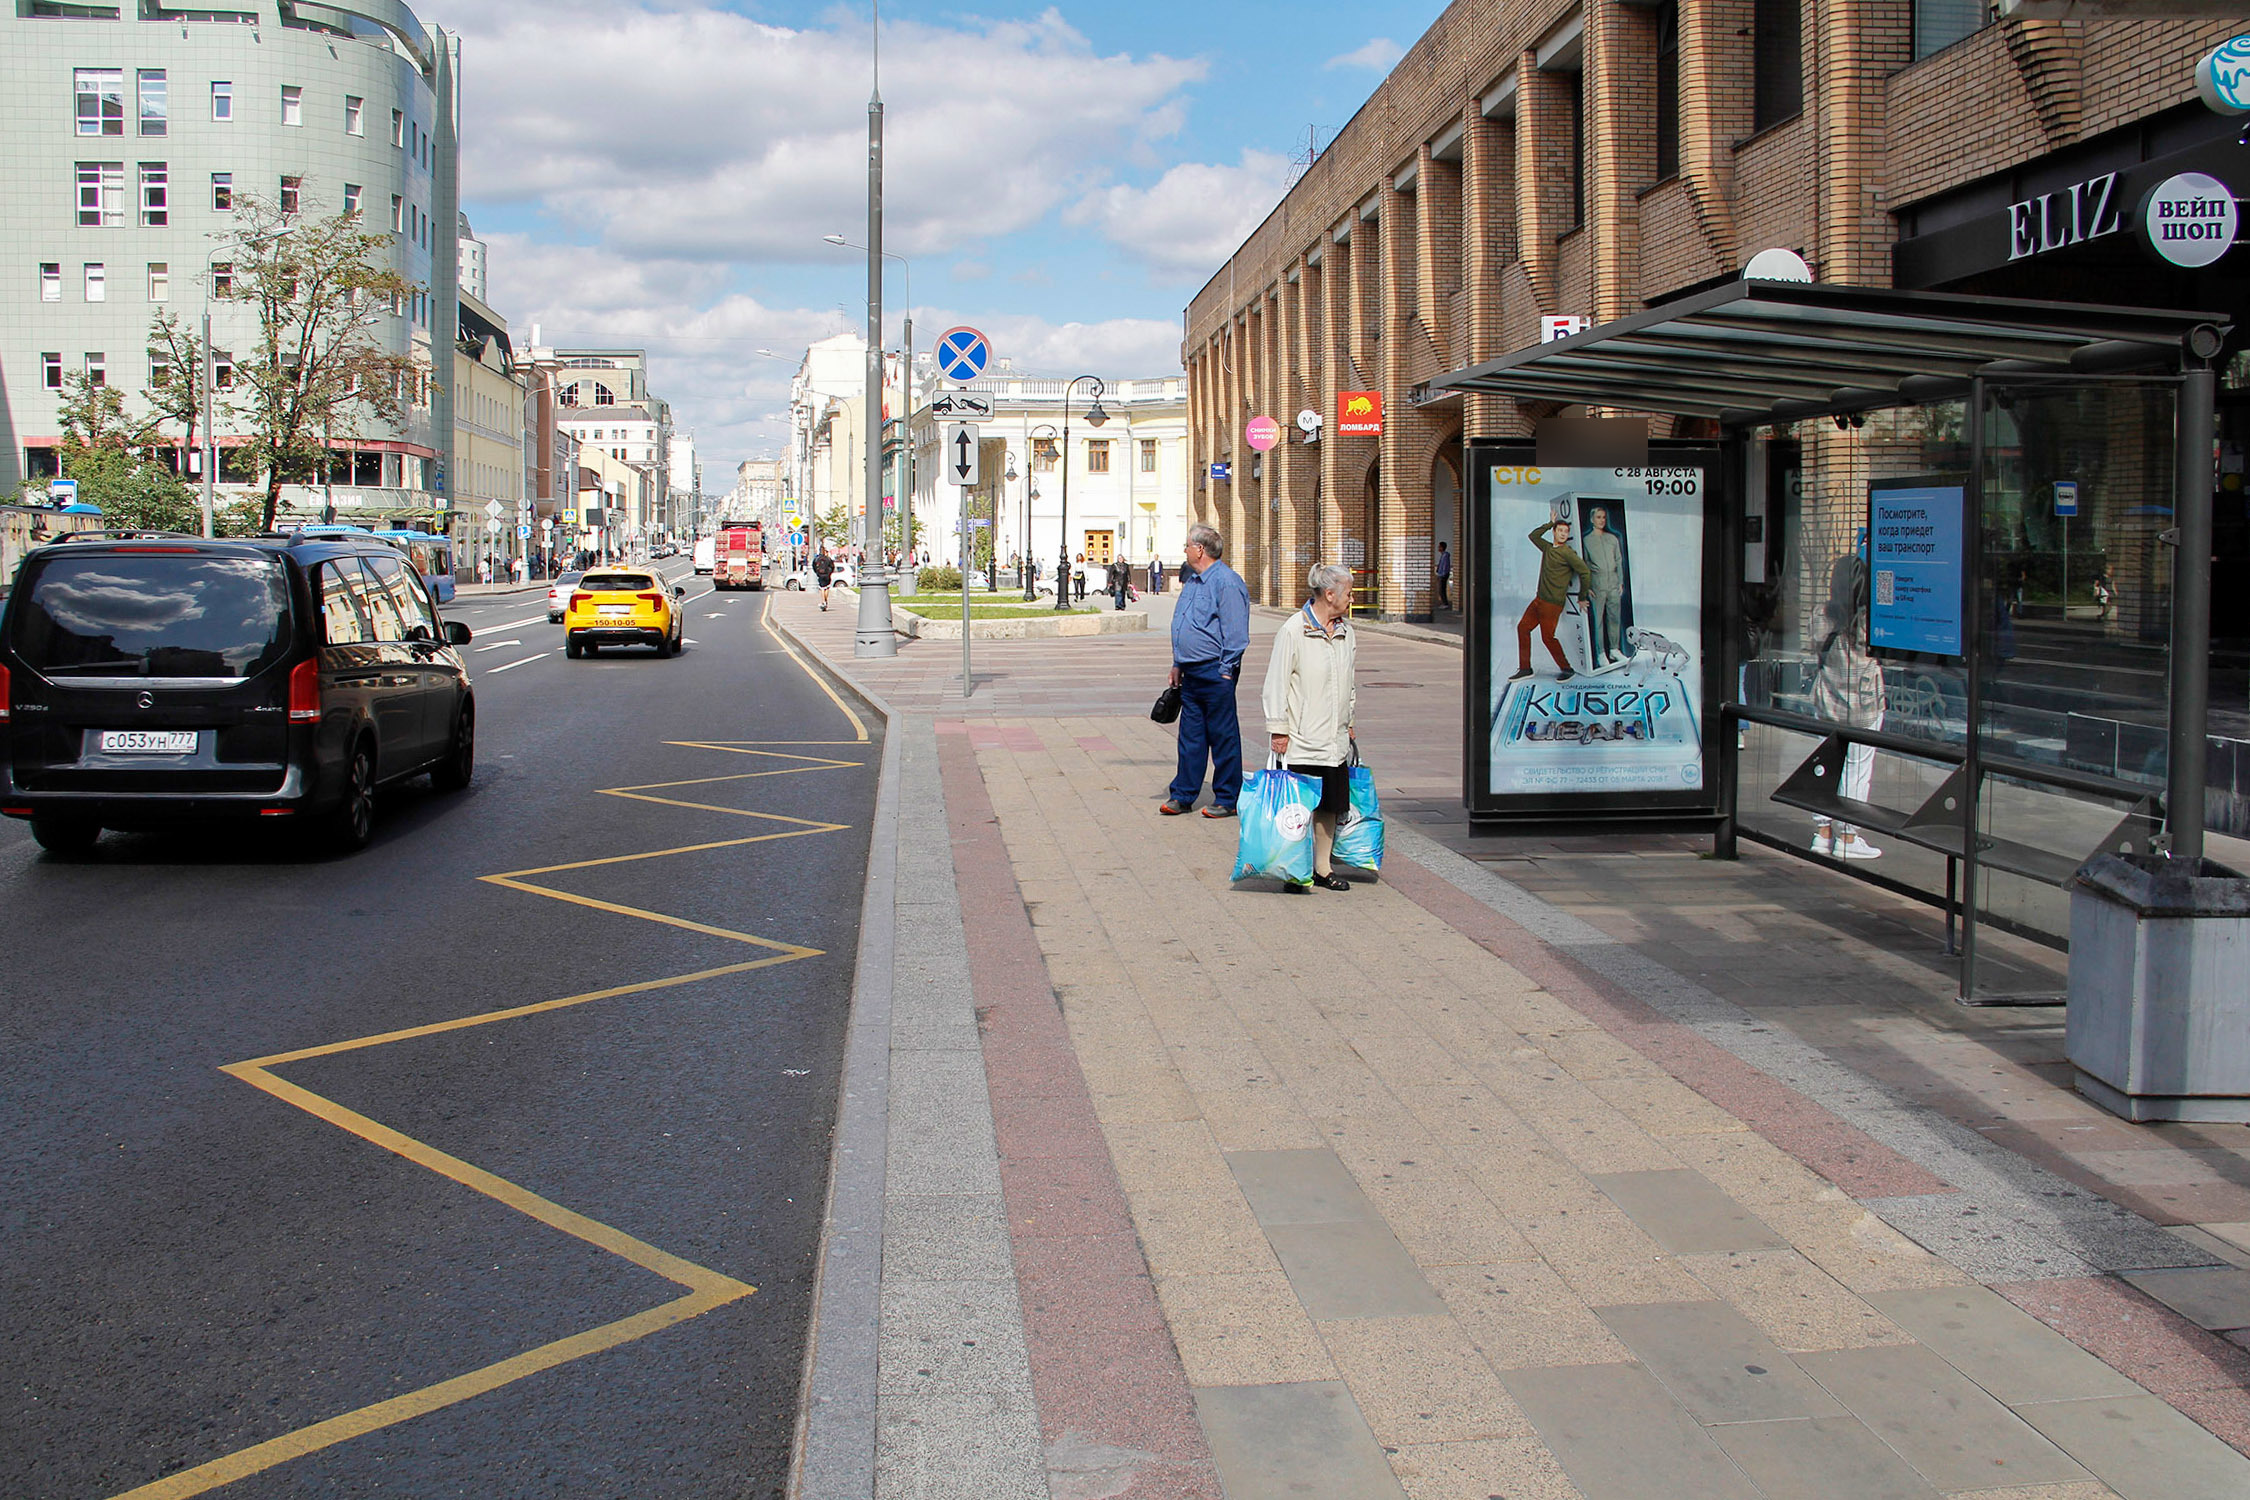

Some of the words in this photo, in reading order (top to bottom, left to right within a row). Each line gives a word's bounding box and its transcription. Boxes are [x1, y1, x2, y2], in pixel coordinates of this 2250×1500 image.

[2158, 196, 2227, 218] ВЕЙП
[2161, 222, 2224, 241] ШОП
[1339, 423, 1380, 432] ЛОМБАРД
[1495, 467, 1542, 485] СТС
[1615, 468, 1624, 477] С
[1627, 468, 1641, 477] 28
[1644, 468, 1697, 478] АВГУСТА
[1645, 480, 1697, 495] 19:00
[309, 495, 362, 506] ЕВАЗИЯ
[1878, 507, 1928, 521] Посмотрите,
[1878, 526, 1899, 538] когда
[1900, 526, 1934, 539] приедет
[1878, 543, 1893, 552] ваш
[1894, 543, 1936, 556] транспорт
[170, 732, 193, 744] 777
